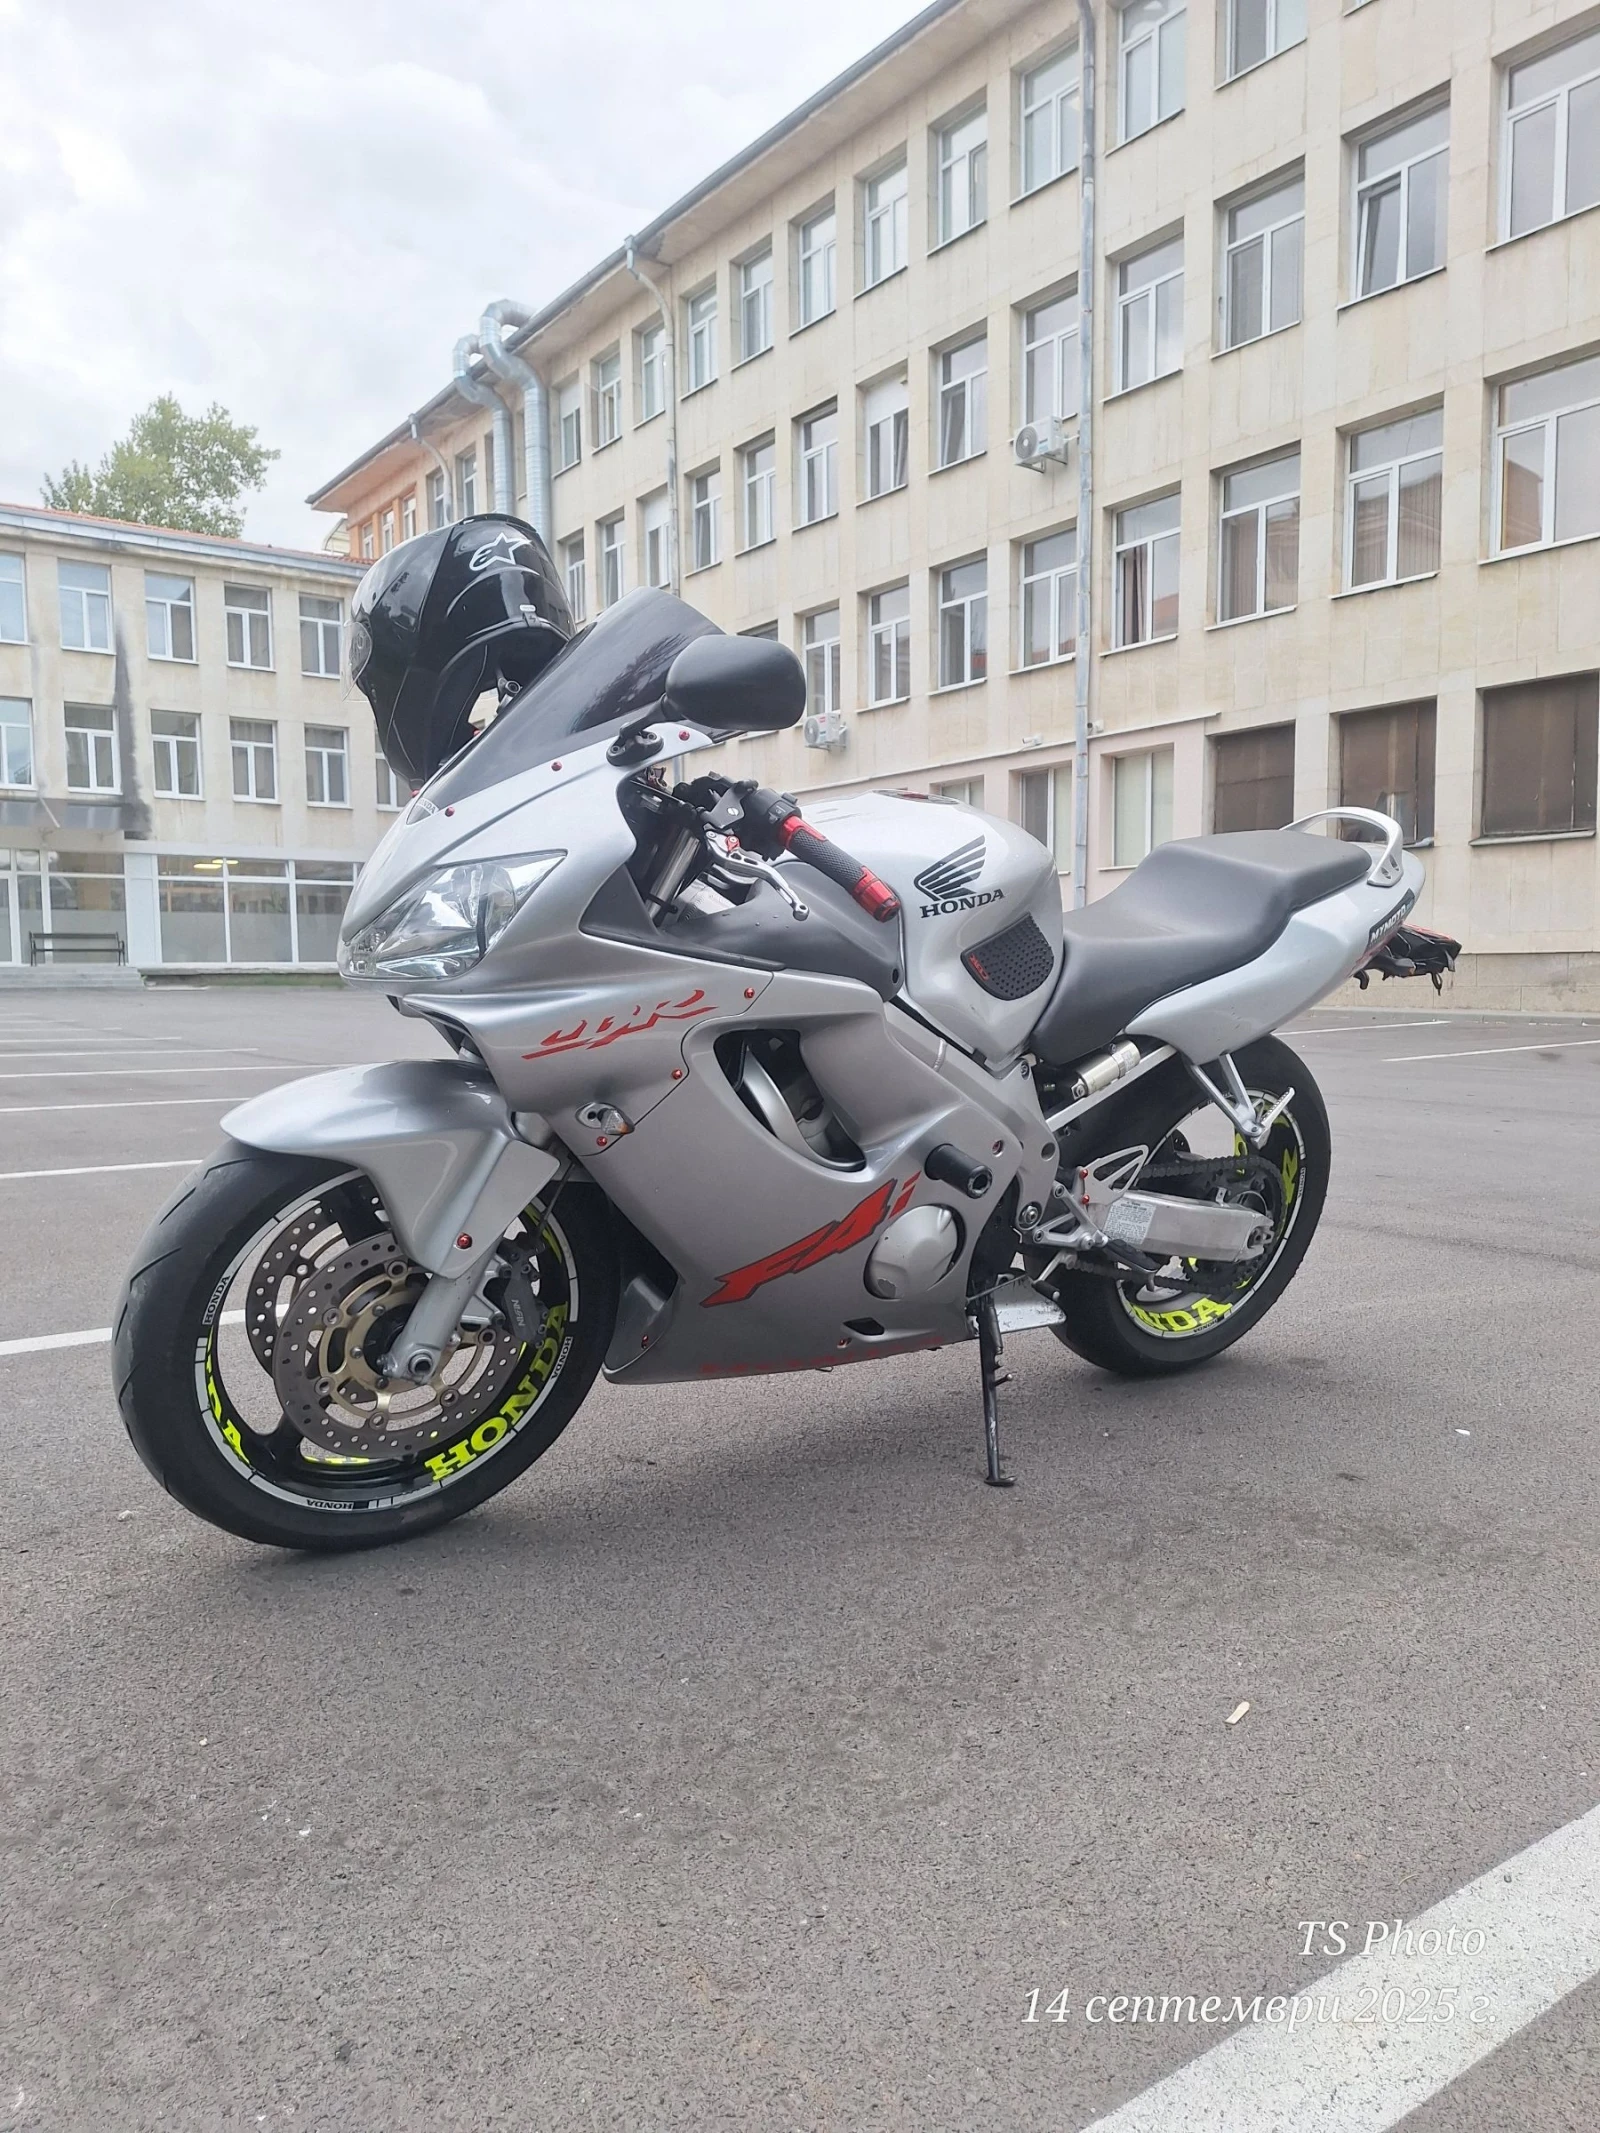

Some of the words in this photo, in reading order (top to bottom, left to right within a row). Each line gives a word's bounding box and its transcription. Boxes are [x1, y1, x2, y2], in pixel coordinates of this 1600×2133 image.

[919, 888, 1005, 919] HONDA
[202, 1275, 231, 1326] HONDA
[551, 1336, 573, 1380] HONDA
[424, 1300, 568, 1481] HONDA
[306, 1499, 353, 1510] HONDA
